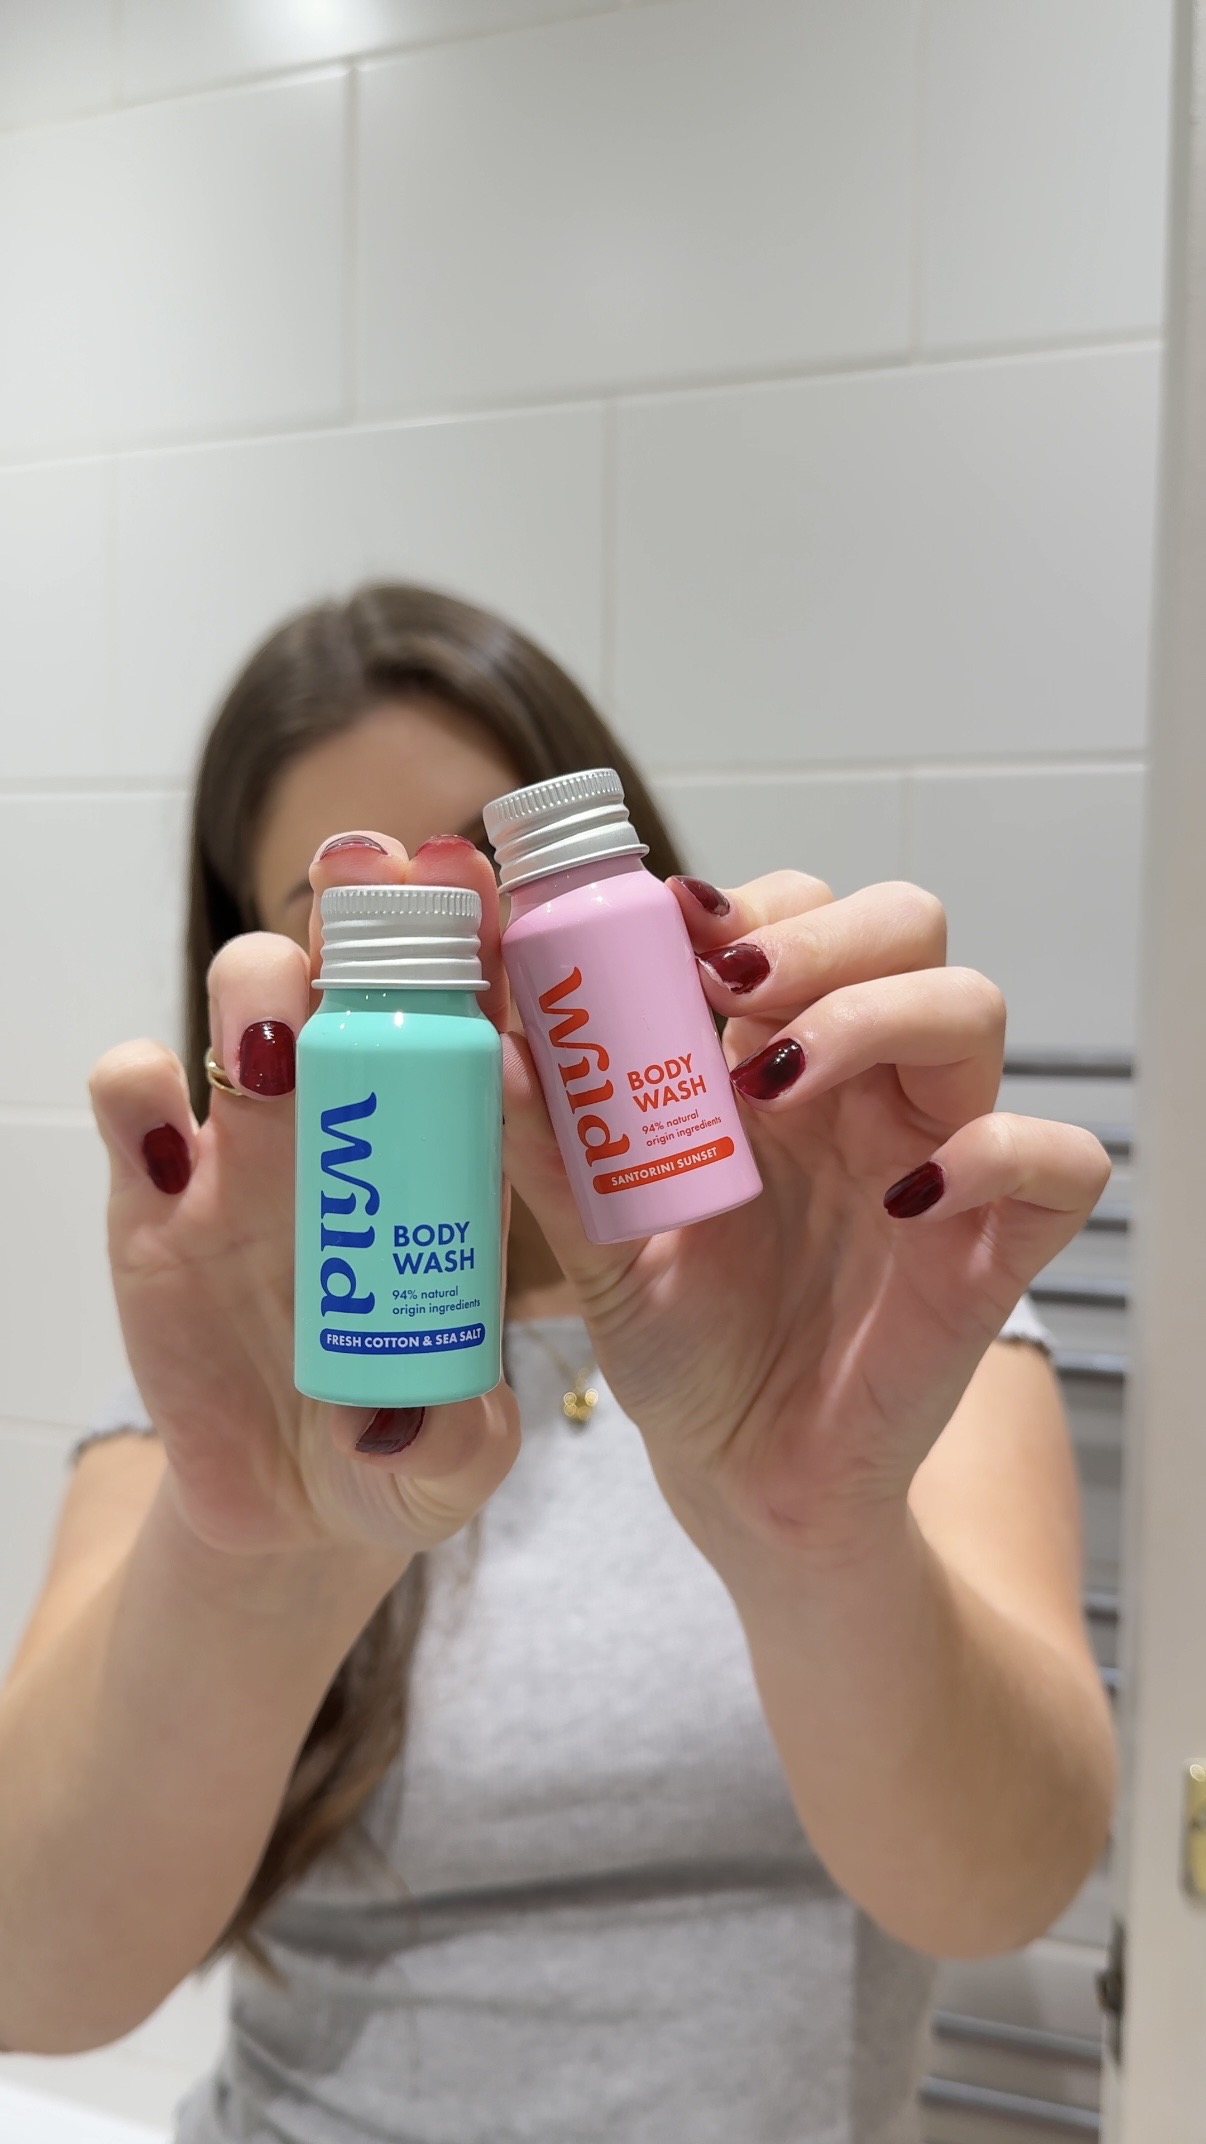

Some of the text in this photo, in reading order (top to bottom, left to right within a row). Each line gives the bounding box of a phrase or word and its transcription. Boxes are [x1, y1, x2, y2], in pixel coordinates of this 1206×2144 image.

[626, 1053, 693, 1092] BODY
[632, 1074, 708, 1115] WASH
[641, 1109, 700, 1136] 94% natural
[646, 1115, 722, 1148] origin ingredients
[610, 1146, 718, 1187] SANTORINI SUNSET
[393, 1221, 471, 1248] BODY
[392, 1248, 476, 1276] WASH
[392, 1285, 459, 1301] 94% natural
[392, 1298, 481, 1318] origin ingredients
[326, 1327, 482, 1348] FRESH COTTON & SEA SALT
